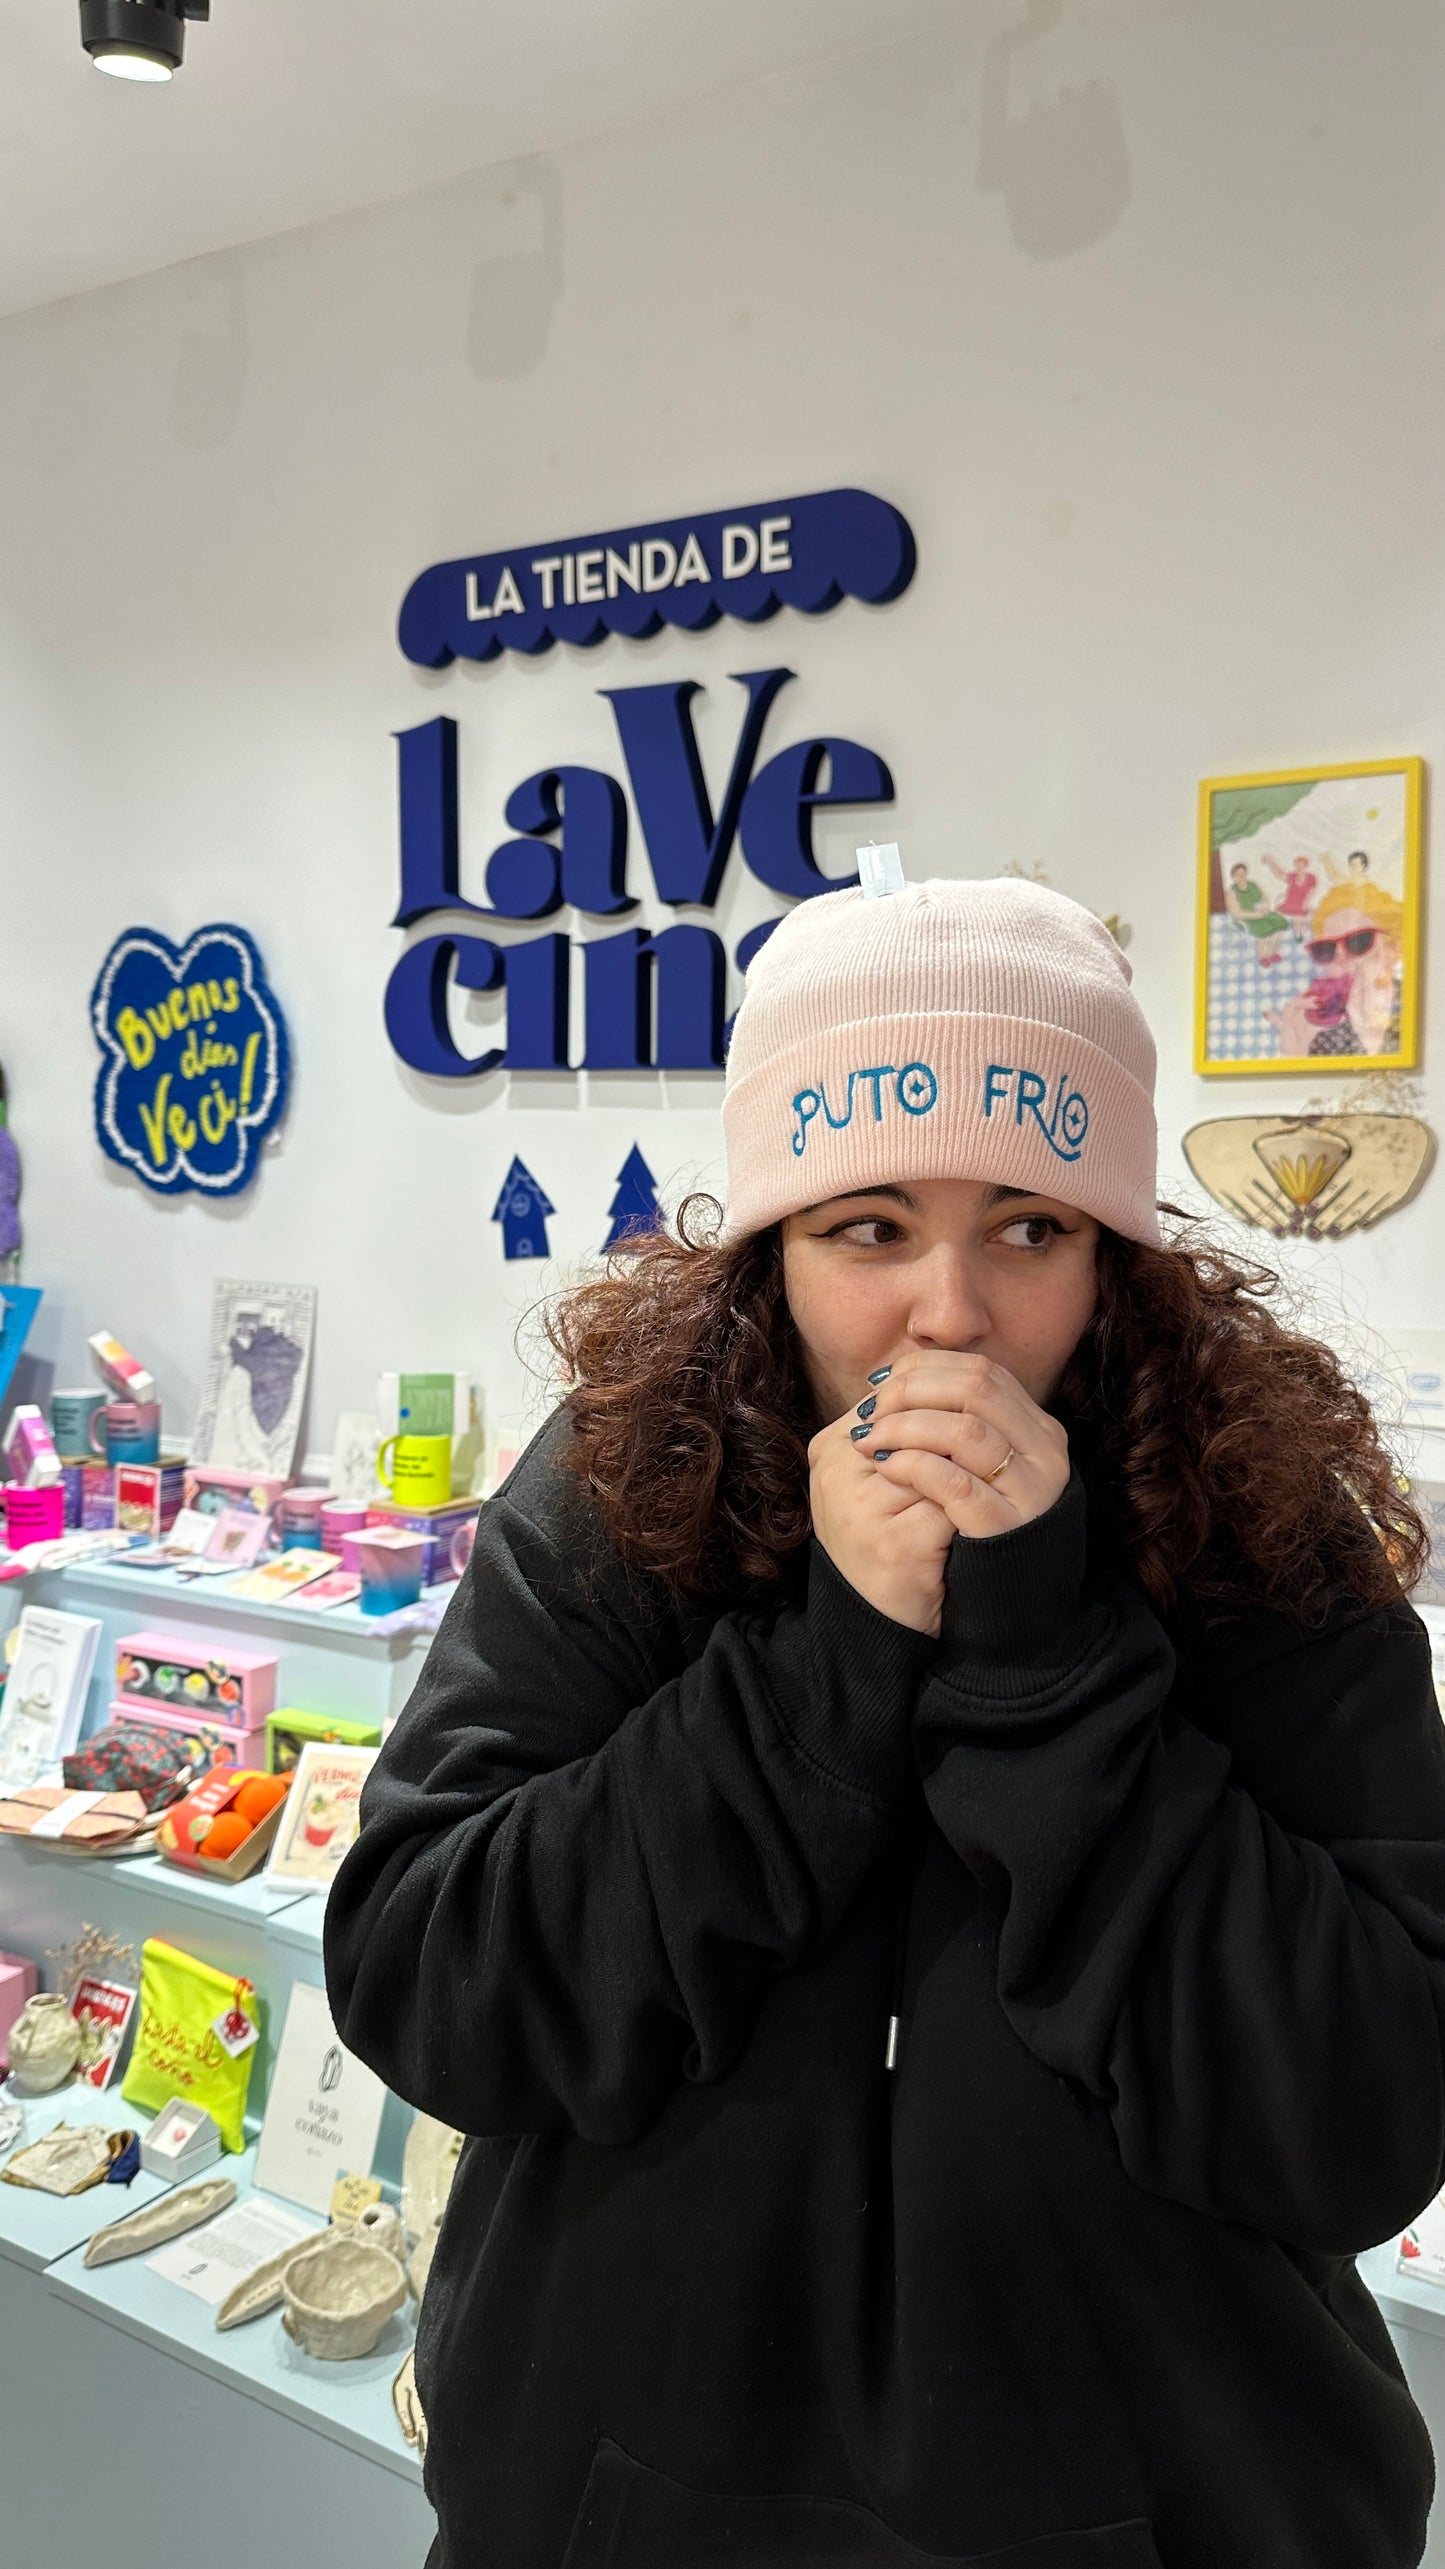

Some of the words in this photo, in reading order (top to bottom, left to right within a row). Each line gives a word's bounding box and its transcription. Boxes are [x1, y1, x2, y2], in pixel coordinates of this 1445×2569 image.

[465, 570, 526, 623] LA
[531, 531, 712, 610] TIENDA
[721, 515, 793, 581] DE
[791, 1061, 938, 1157] PUTO
